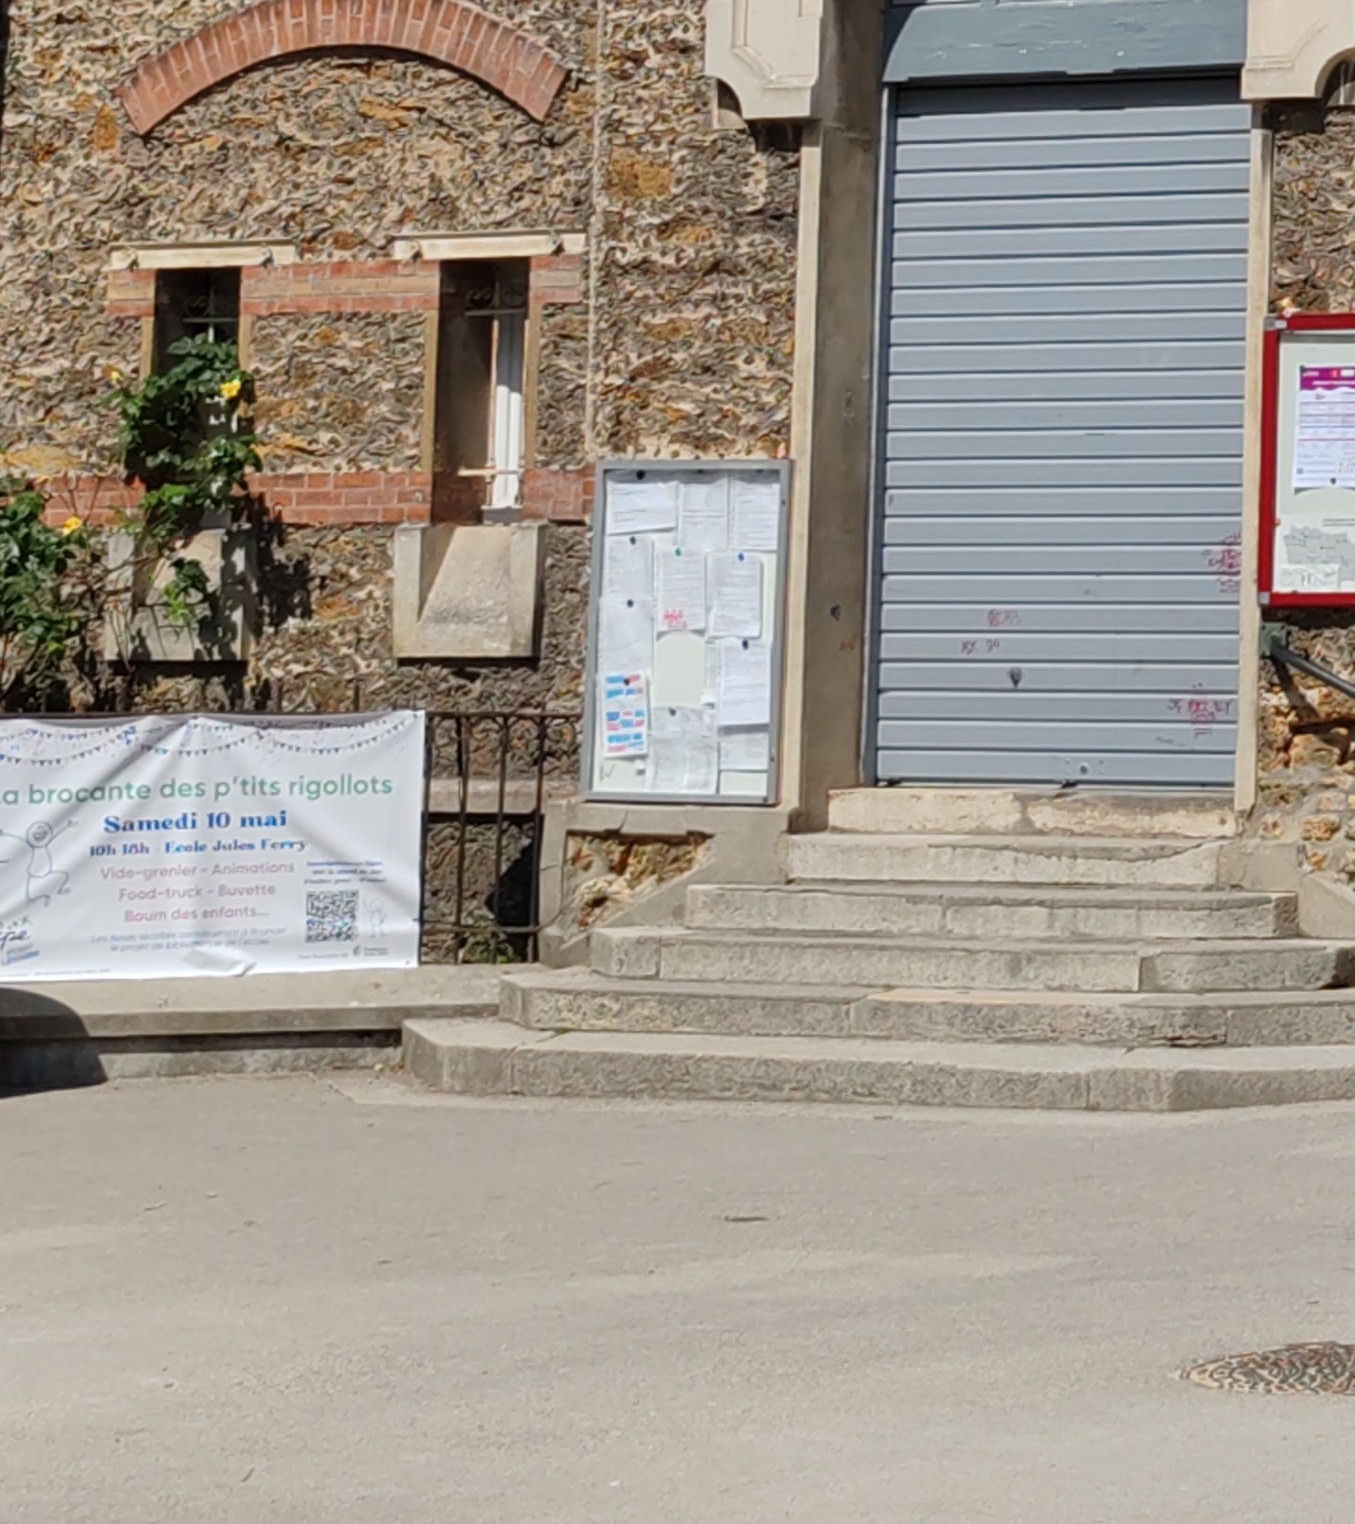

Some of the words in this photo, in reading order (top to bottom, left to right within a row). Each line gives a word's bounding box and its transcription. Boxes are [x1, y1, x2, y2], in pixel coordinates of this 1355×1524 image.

[0, 787, 19, 806] a
[28, 781, 151, 804] brocante
[159, 777, 206, 799] des
[213, 775, 281, 802] p'tits
[289, 773, 393, 801] rigollots
[103, 812, 197, 834] Samedi
[206, 811, 231, 829] 10
[240, 809, 287, 828] mai
[212, 838, 256, 852] Jules
[261, 837, 307, 852] Ferry
[100, 864, 197, 881] Vide-grenier
[212, 862, 294, 875] Animations
[118, 885, 204, 901] Food-truck
[218, 883, 276, 897] Buvette
[124, 909, 167, 923] Boum
[171, 907, 198, 920] des
